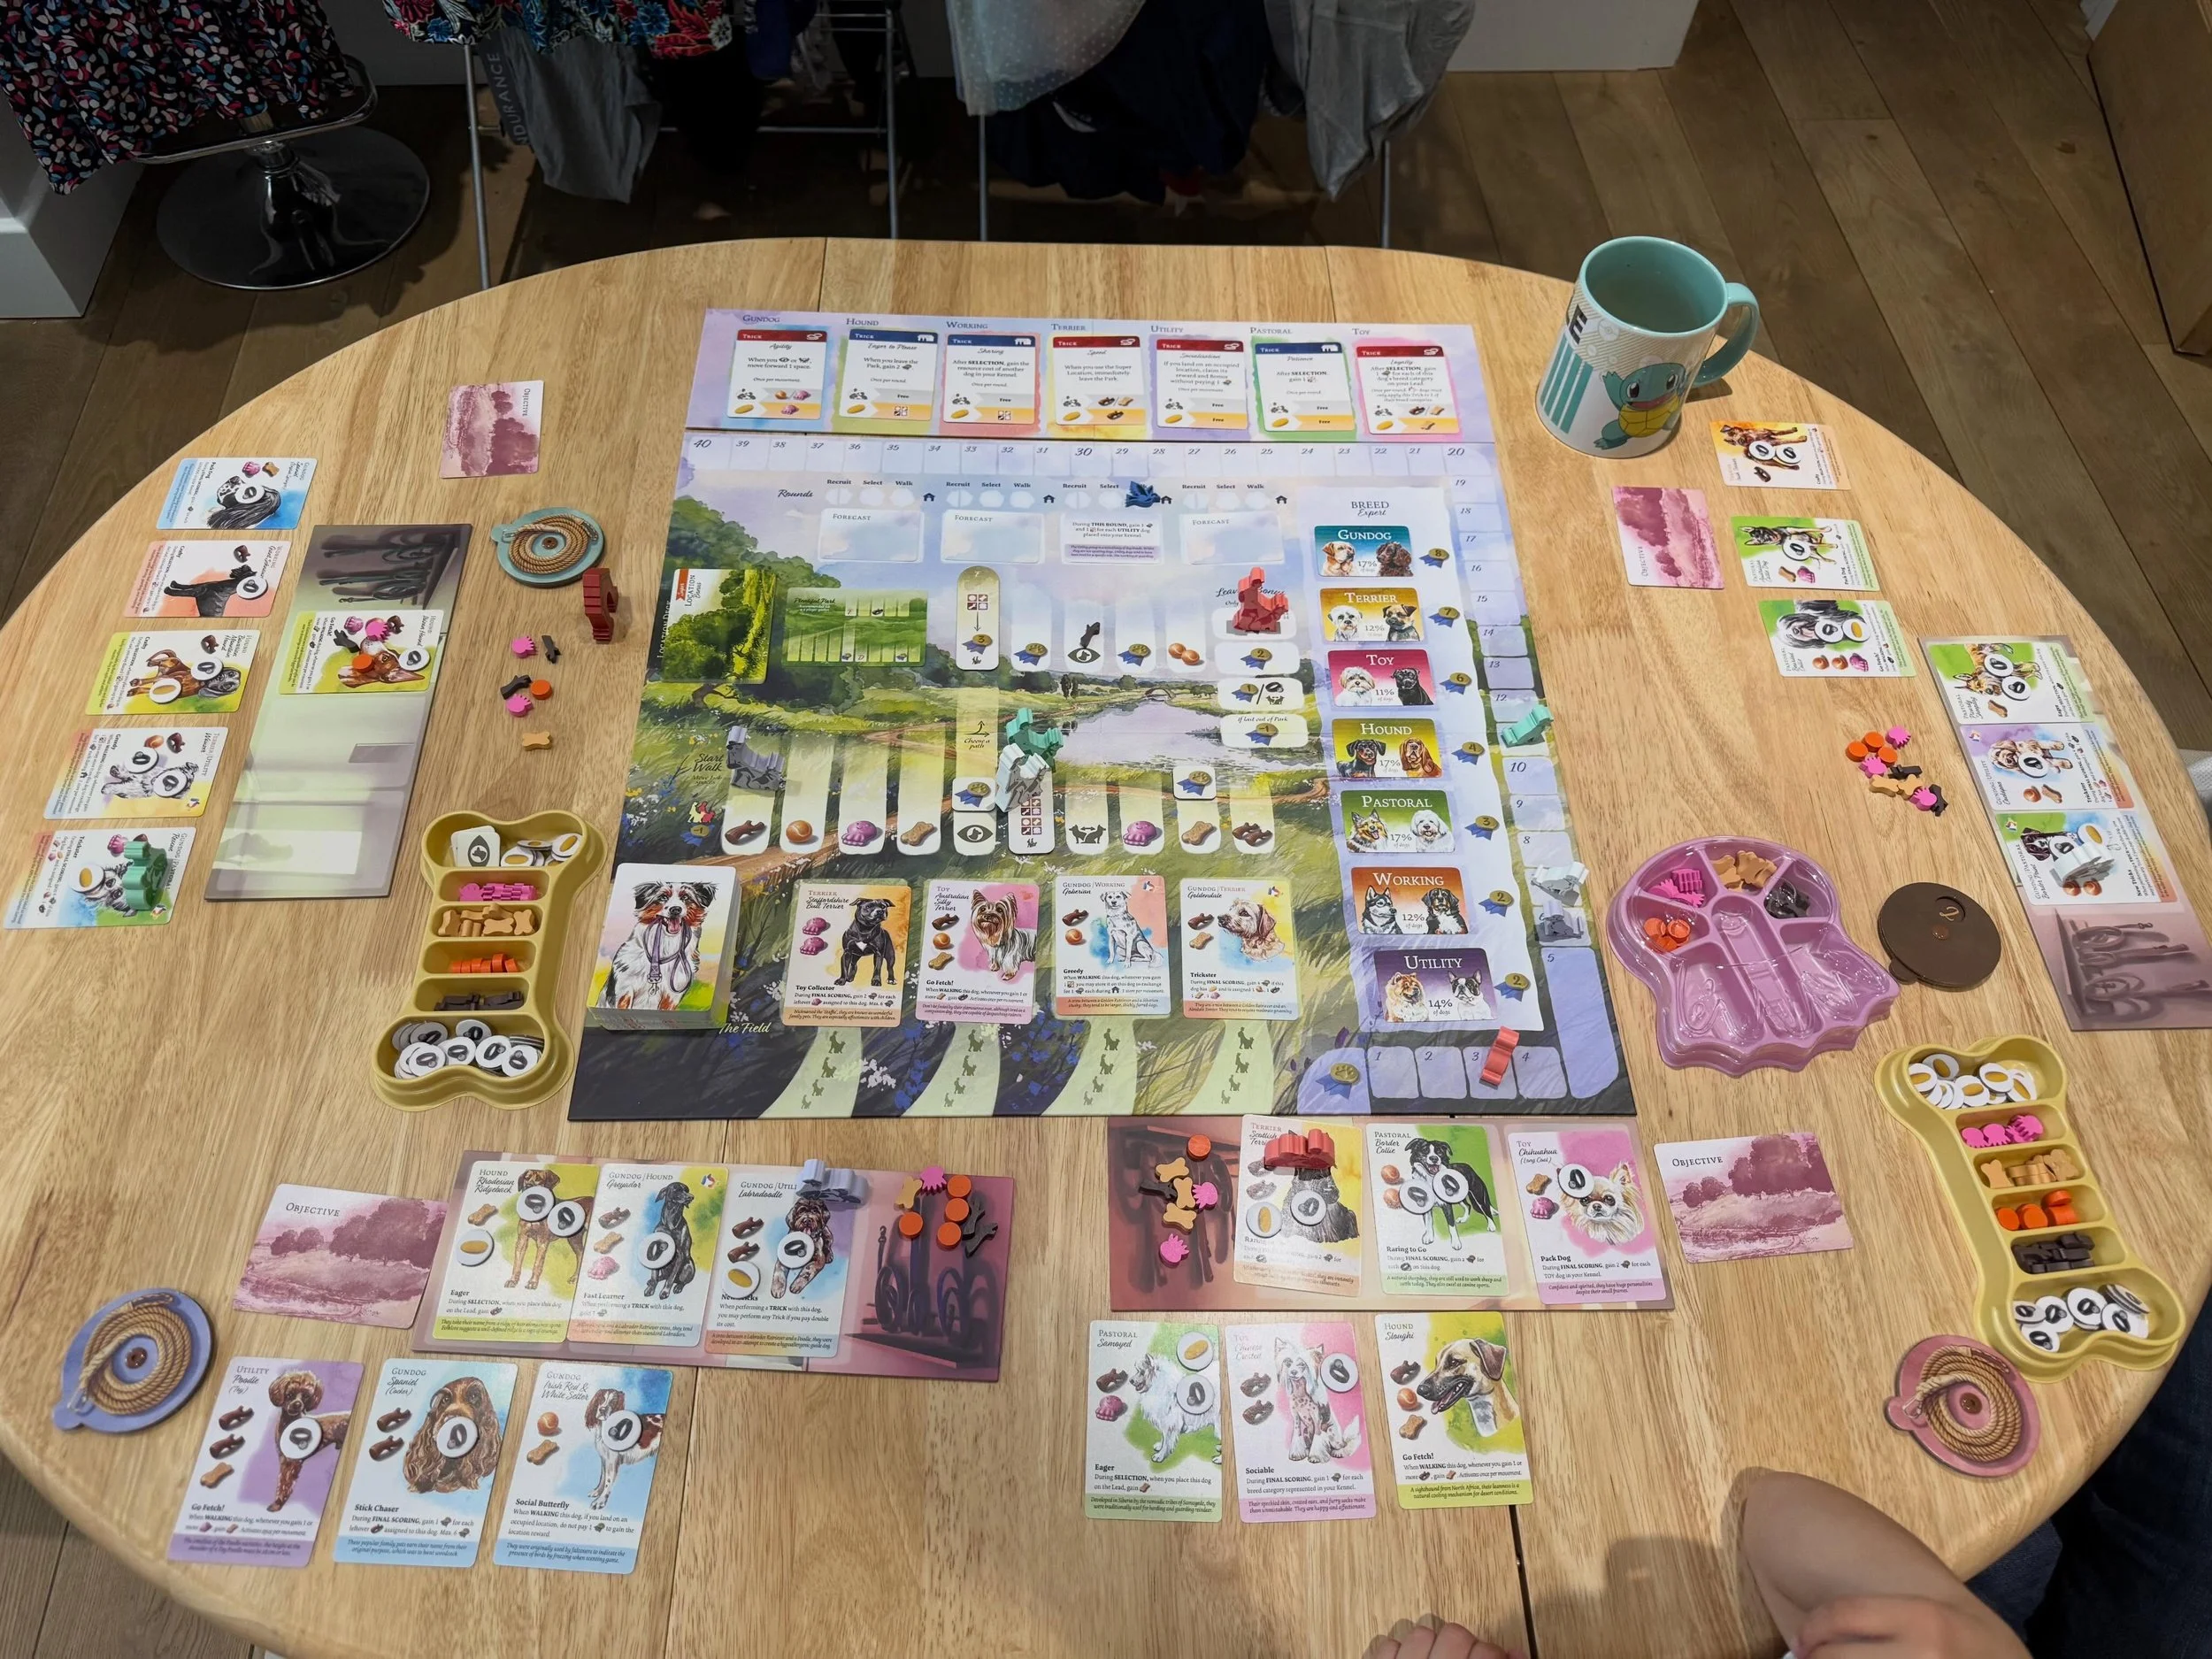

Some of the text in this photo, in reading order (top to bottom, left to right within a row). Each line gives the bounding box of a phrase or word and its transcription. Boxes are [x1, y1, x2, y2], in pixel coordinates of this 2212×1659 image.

[742, 314, 780, 323] GUNDOG
[846, 318, 879, 326] HOUND
[946, 320, 988, 329] WORKING
[1150, 325, 1184, 334] UTILITY
[1568, 303, 1588, 346] E
[694, 439, 712, 449] 40
[1074, 447, 1092, 457] 30
[1447, 447, 1465, 457] 20
[1454, 479, 1466, 488] 19
[778, 488, 814, 499] Rounds
[1350, 501, 1389, 510] BREED
[1356, 508, 1386, 518] Expert
[1337, 529, 1392, 541] GUNDOG
[1465, 534, 1477, 543] 17
[1637, 545, 1649, 578] OBJECTIVE
[685, 574, 696, 607] LOCATION
[1216, 587, 1238, 597] Leav
[1343, 592, 1398, 603] TERRIER
[1365, 654, 1394, 665] TOY
[1487, 660, 1501, 669] 13
[1779, 647, 1791, 672] PASTORAL
[1955, 694, 1969, 719] PASTORAL
[1359, 723, 1412, 735] HOUND
[111, 733, 120, 750] Greedy
[695, 753, 725, 763] Start
[1379, 758, 1401, 767] 17%
[693, 762, 723, 772] Walk
[1509, 761, 1526, 773] 10
[2080, 782, 2093, 804] Trickster
[1361, 795, 1432, 809] PASTORAL
[1515, 799, 1524, 809] 9
[73, 835, 85, 858] Trickster
[1372, 872, 1444, 887] WORKING
[1187, 891, 1223, 900] Goldendale
[1403, 955, 1463, 971] UTILITY
[1427, 999, 1453, 1009] 14%
[741, 1022, 771, 1034] Field
[1373, 1050, 1381, 1061] 1
[1250, 1122, 1282, 1133] TERRIER
[1248, 1130, 1279, 1140] Scottish
[1374, 1139, 1400, 1148] Border
[1375, 1146, 1396, 1155] Collie
[1517, 1147, 1557, 1157] Chihuahua
[1519, 1156, 1553, 1166] (Long Coat)
[1671, 1154, 1723, 1168] OBJECTIVE
[476, 1176, 516, 1187] Rhodesian
[606, 1179, 642, 1191] Greyador
[474, 1184, 513, 1194] Ridgeback
[738, 1188, 784, 1199] Labradoodle
[285, 1201, 342, 1219] OBJECTIVE
[1386, 1245, 1408, 1255] Raring
[449, 1288, 471, 1297] Eager
[1098, 1329, 1138, 1339] PASTORAL
[1384, 1330, 1414, 1341] Sloughi
[1096, 1338, 1133, 1348] Samoyed
[236, 1365, 270, 1375] UTILITY
[391, 1367, 427, 1377] GUNDOG
[233, 1374, 261, 1385] Poodle
[546, 1371, 582, 1380] GUNDOG
[387, 1376, 419, 1388] Spaniel
[543, 1380, 590, 1392] Irish Red &
[228, 1386, 250, 1395] (Toy)
[385, 1386, 414, 1397] (Cocker)
[541, 1389, 591, 1402] White Setter
[1413, 1452, 1434, 1461] Fetch!
[1094, 1463, 1115, 1473] Eager
[1114, 1474, 1149, 1483] SELECTION,
[191, 1503, 227, 1513] Go Fetch!
[354, 1503, 400, 1514] Stick Chaser
[515, 1498, 570, 1512] Social Butterfly
